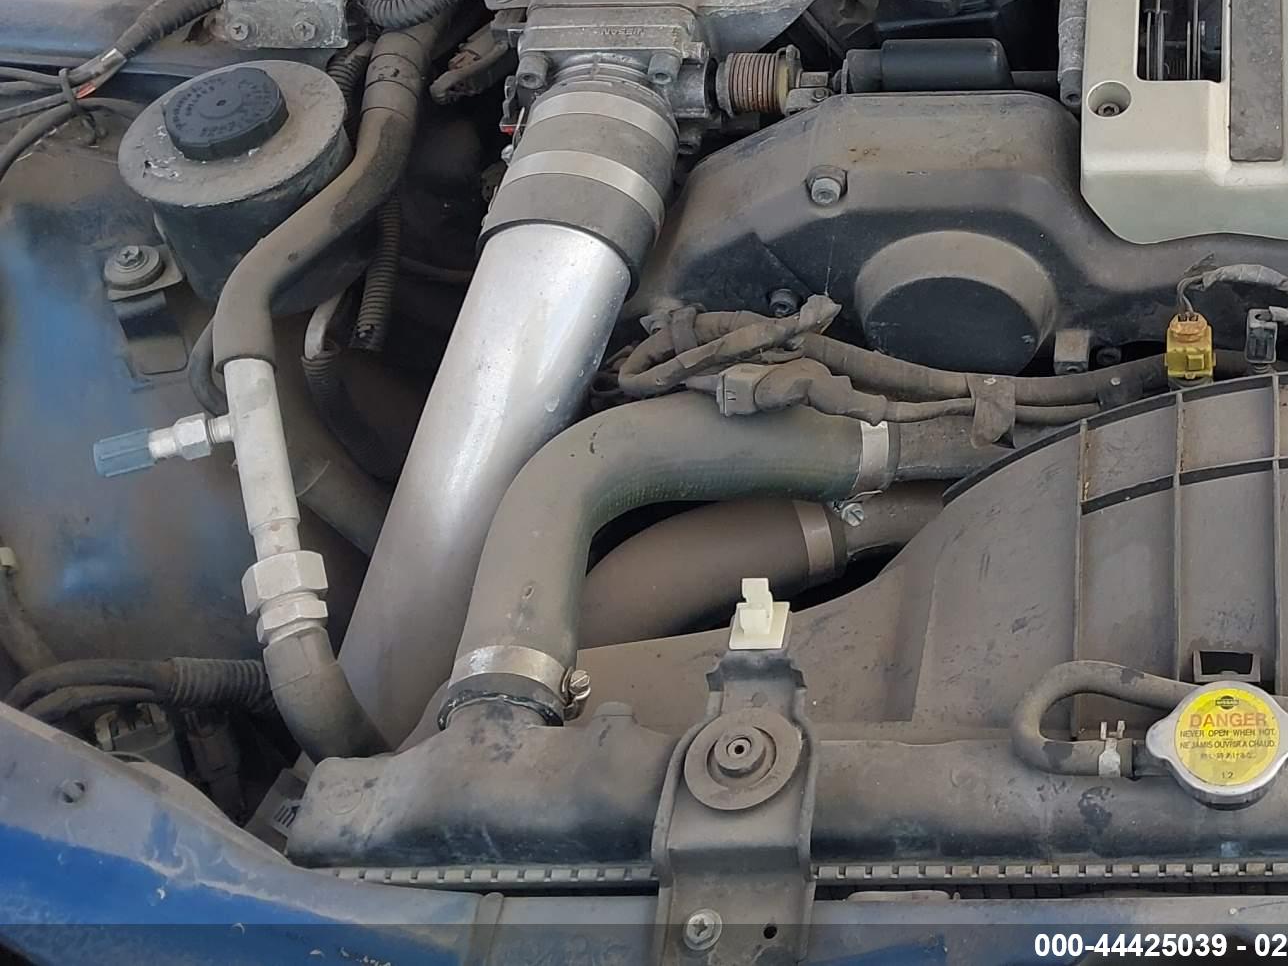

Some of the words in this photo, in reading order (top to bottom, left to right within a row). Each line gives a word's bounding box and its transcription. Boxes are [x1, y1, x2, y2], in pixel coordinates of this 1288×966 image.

[1190, 713, 1267, 728] DANGER
[1180, 729, 1205, 738] NEVER
[1208, 729, 1229, 737] OPEN
[1232, 729, 1256, 737] WHEN
